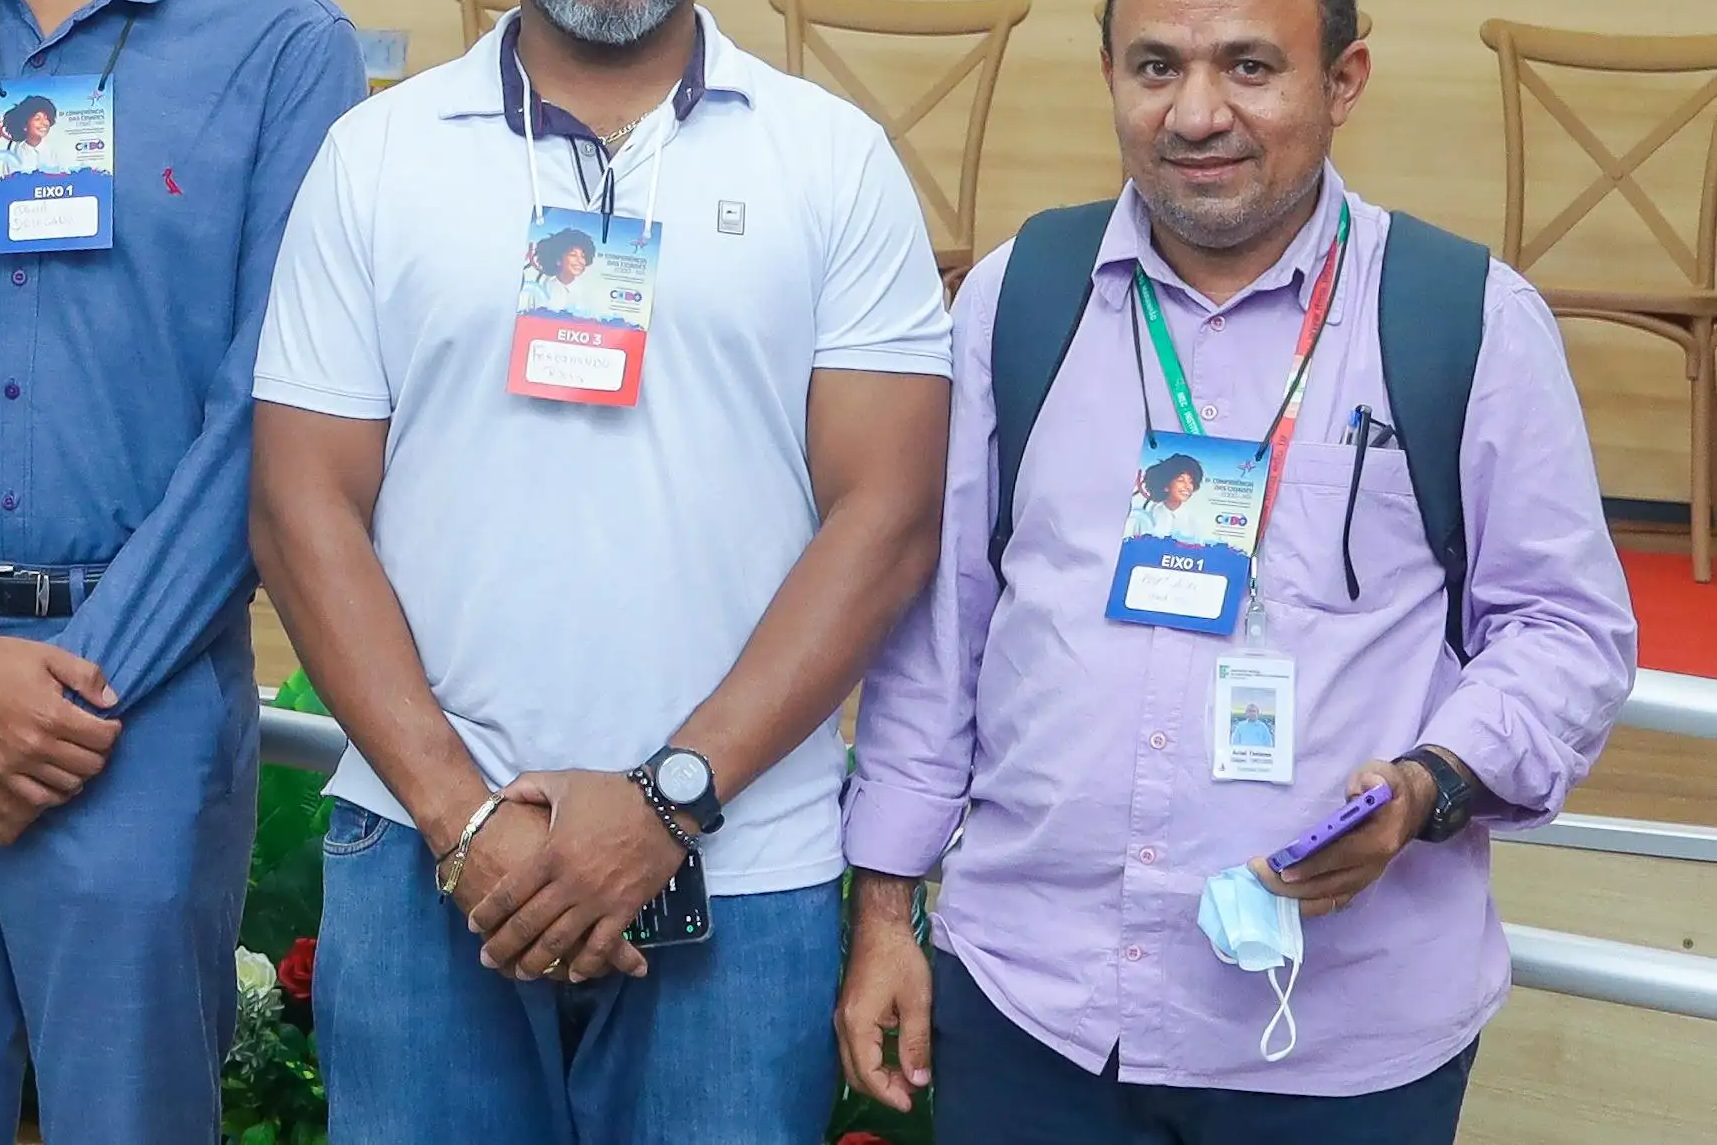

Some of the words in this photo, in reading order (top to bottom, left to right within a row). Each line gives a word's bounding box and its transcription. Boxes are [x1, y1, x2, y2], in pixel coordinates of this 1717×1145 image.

[34, 186, 65, 198] EIXO
[66, 185, 73, 196] 1
[557, 329, 590, 344] EIXO
[592, 333, 602, 346] 3
[1161, 555, 1194, 570] EIXO
[1196, 558, 1204, 571] 1
